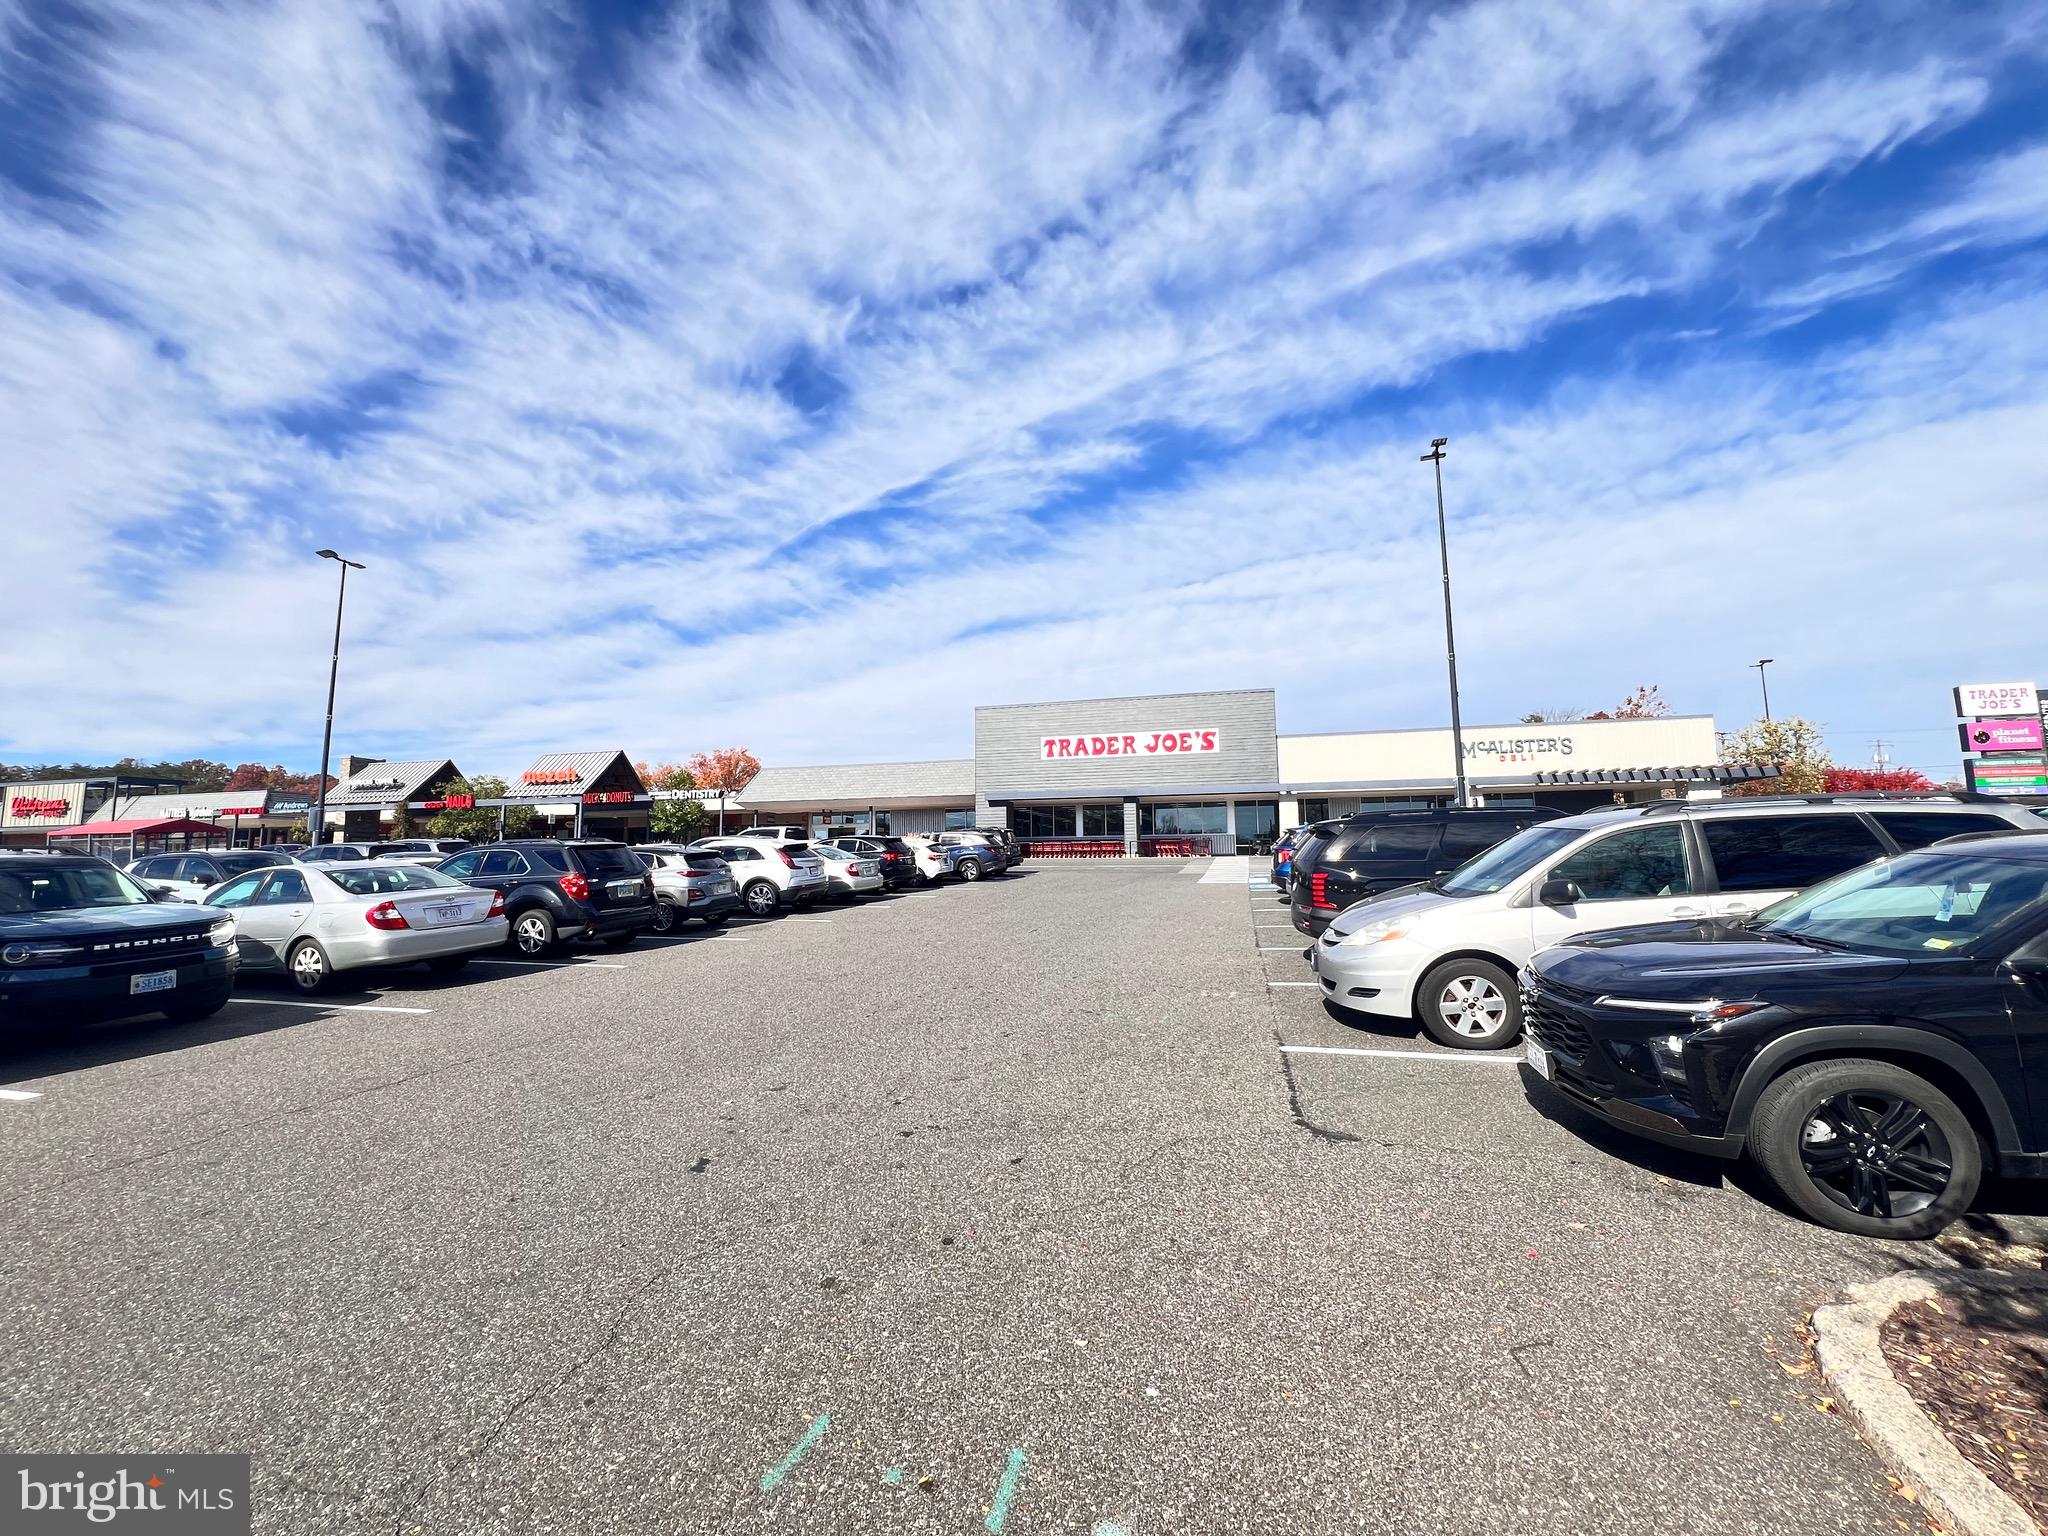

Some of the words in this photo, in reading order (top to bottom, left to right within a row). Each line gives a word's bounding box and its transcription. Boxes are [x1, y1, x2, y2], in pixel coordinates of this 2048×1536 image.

[1969, 688, 2029, 699] TRADER
[1978, 699, 2021, 709] JOE'S
[1992, 728, 2029, 738] planet
[1044, 736, 1136, 758] TRADER
[1144, 731, 1216, 753] JOE'S
[1499, 754, 1535, 762] DELI
[672, 789, 720, 800] DENTISTRY
[94, 934, 199, 950] BRONCO
